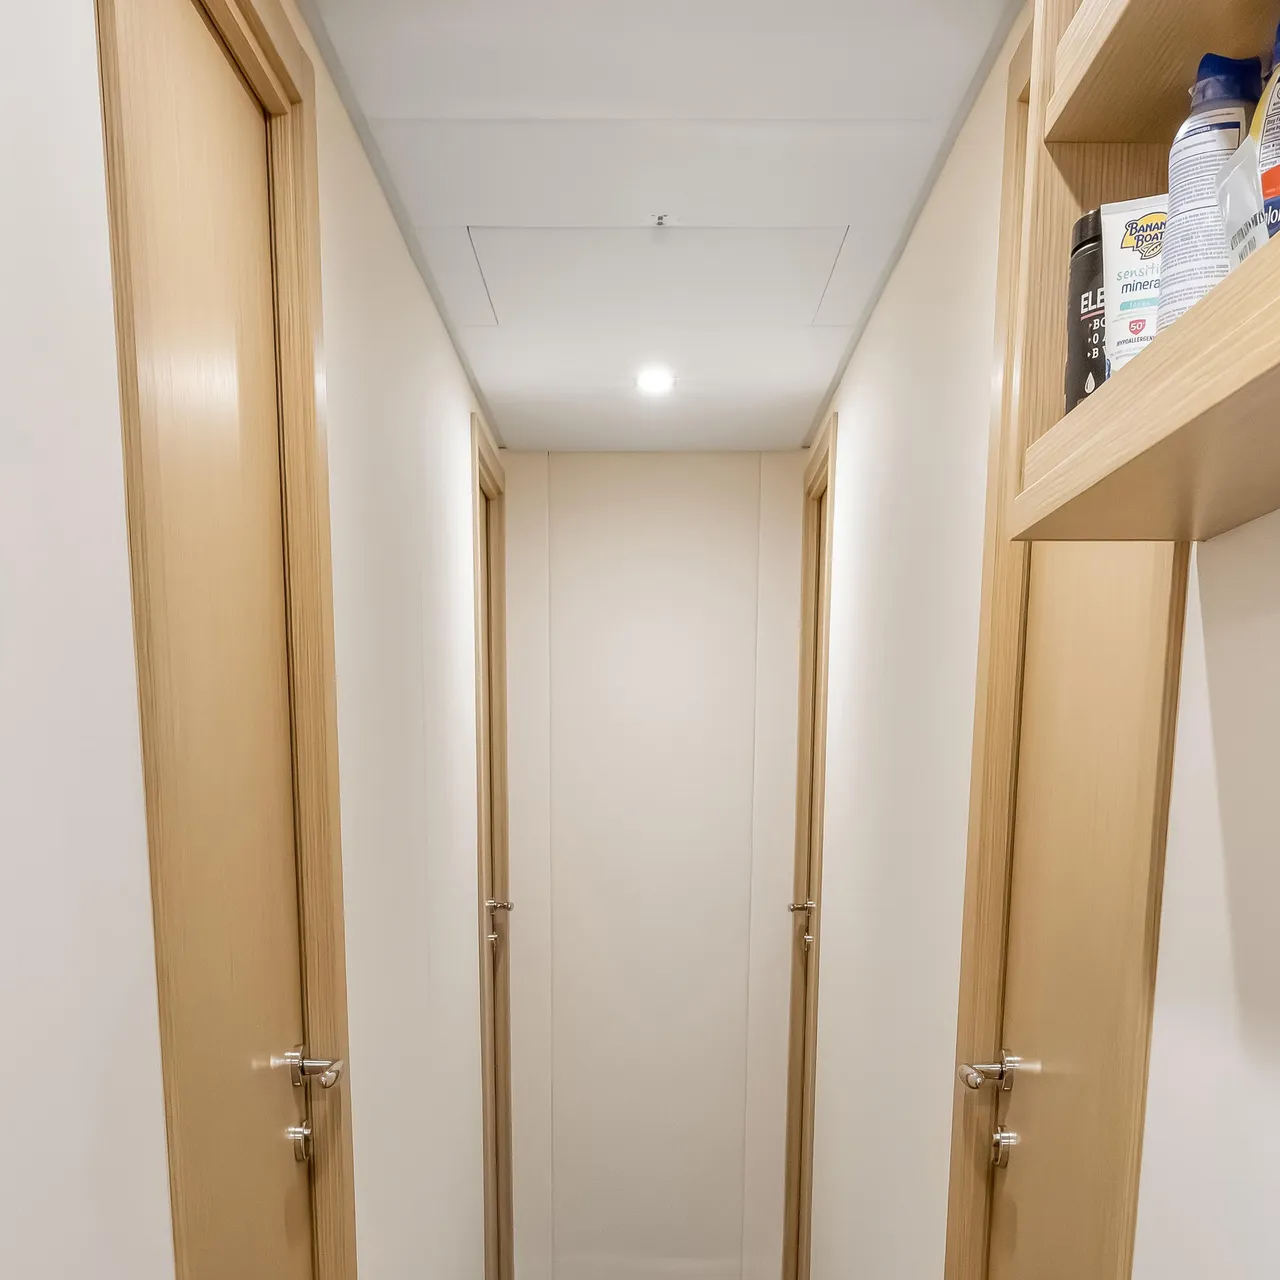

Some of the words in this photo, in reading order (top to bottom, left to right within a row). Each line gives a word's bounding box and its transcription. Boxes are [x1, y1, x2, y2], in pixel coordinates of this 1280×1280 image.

[1128, 221, 1167, 236] BANAN
[1134, 231, 1165, 249] BOAT
[1116, 263, 1160, 281] sensiti
[1121, 279, 1160, 294] minera
[1080, 287, 1105, 314] ELE
